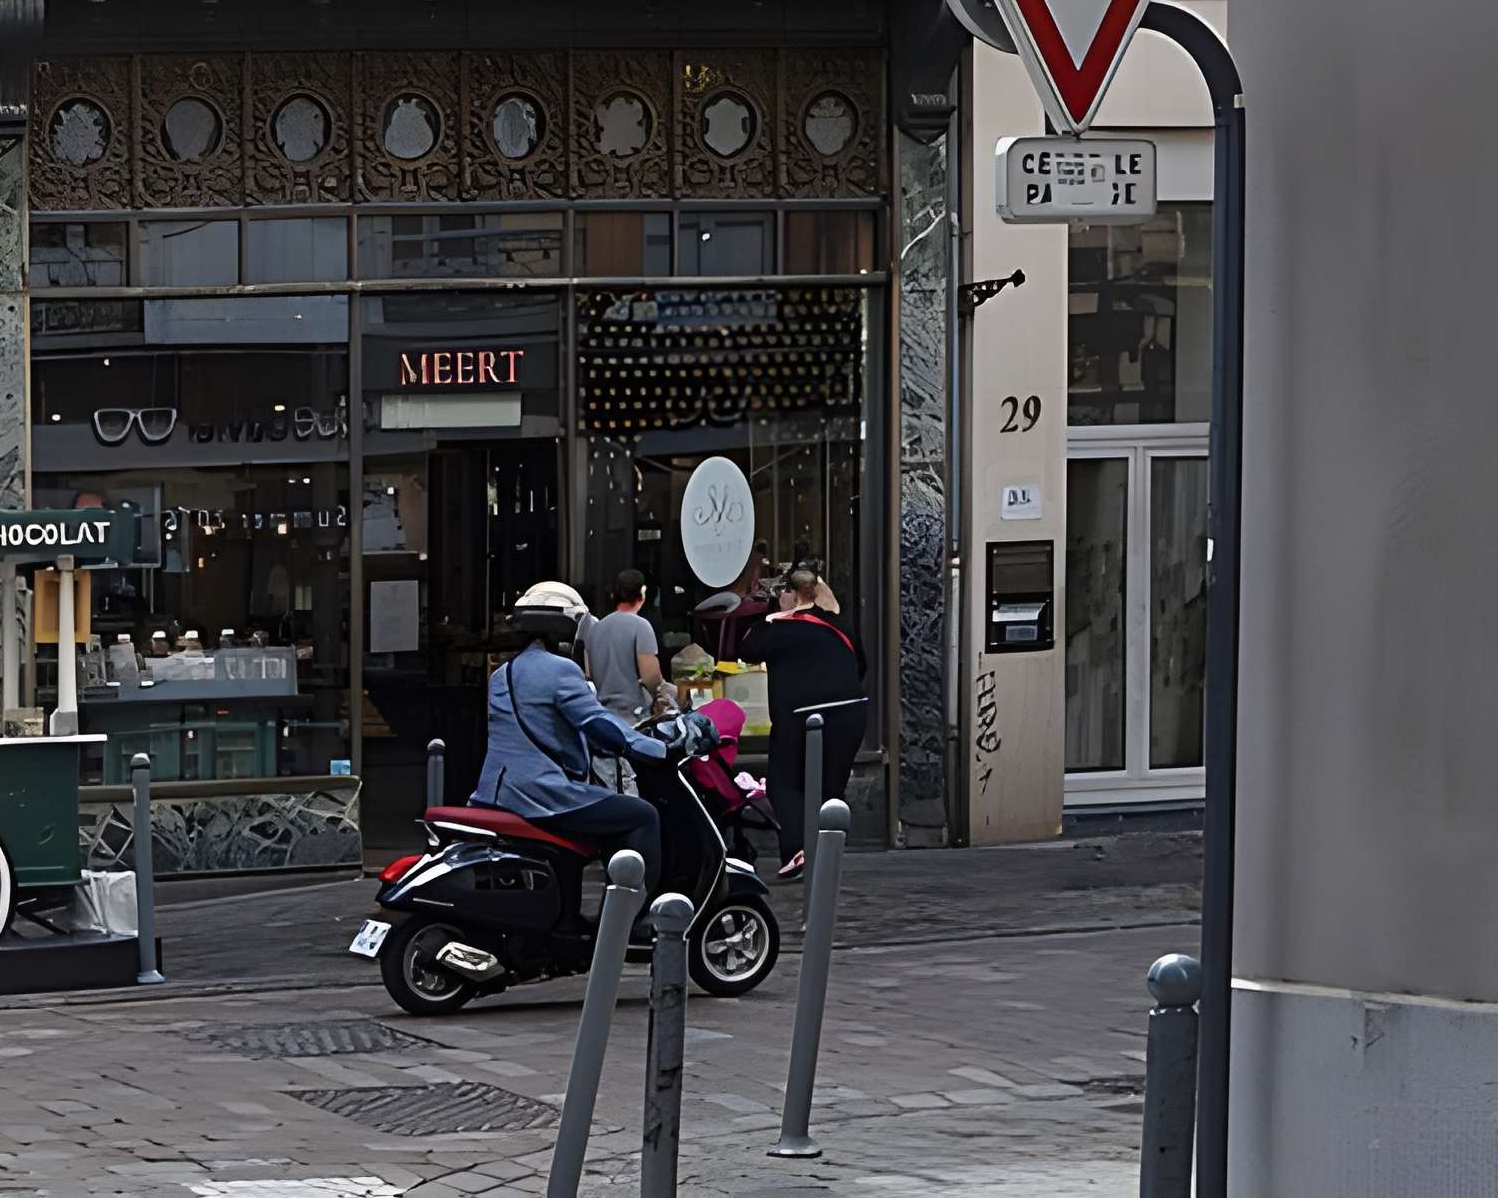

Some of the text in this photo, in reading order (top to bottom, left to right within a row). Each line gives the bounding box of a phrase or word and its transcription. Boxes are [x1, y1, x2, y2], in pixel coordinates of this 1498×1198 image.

[1115, 154, 1142, 175] LE
[400, 350, 524, 385] MEERT
[999, 395, 1042, 433] 29
